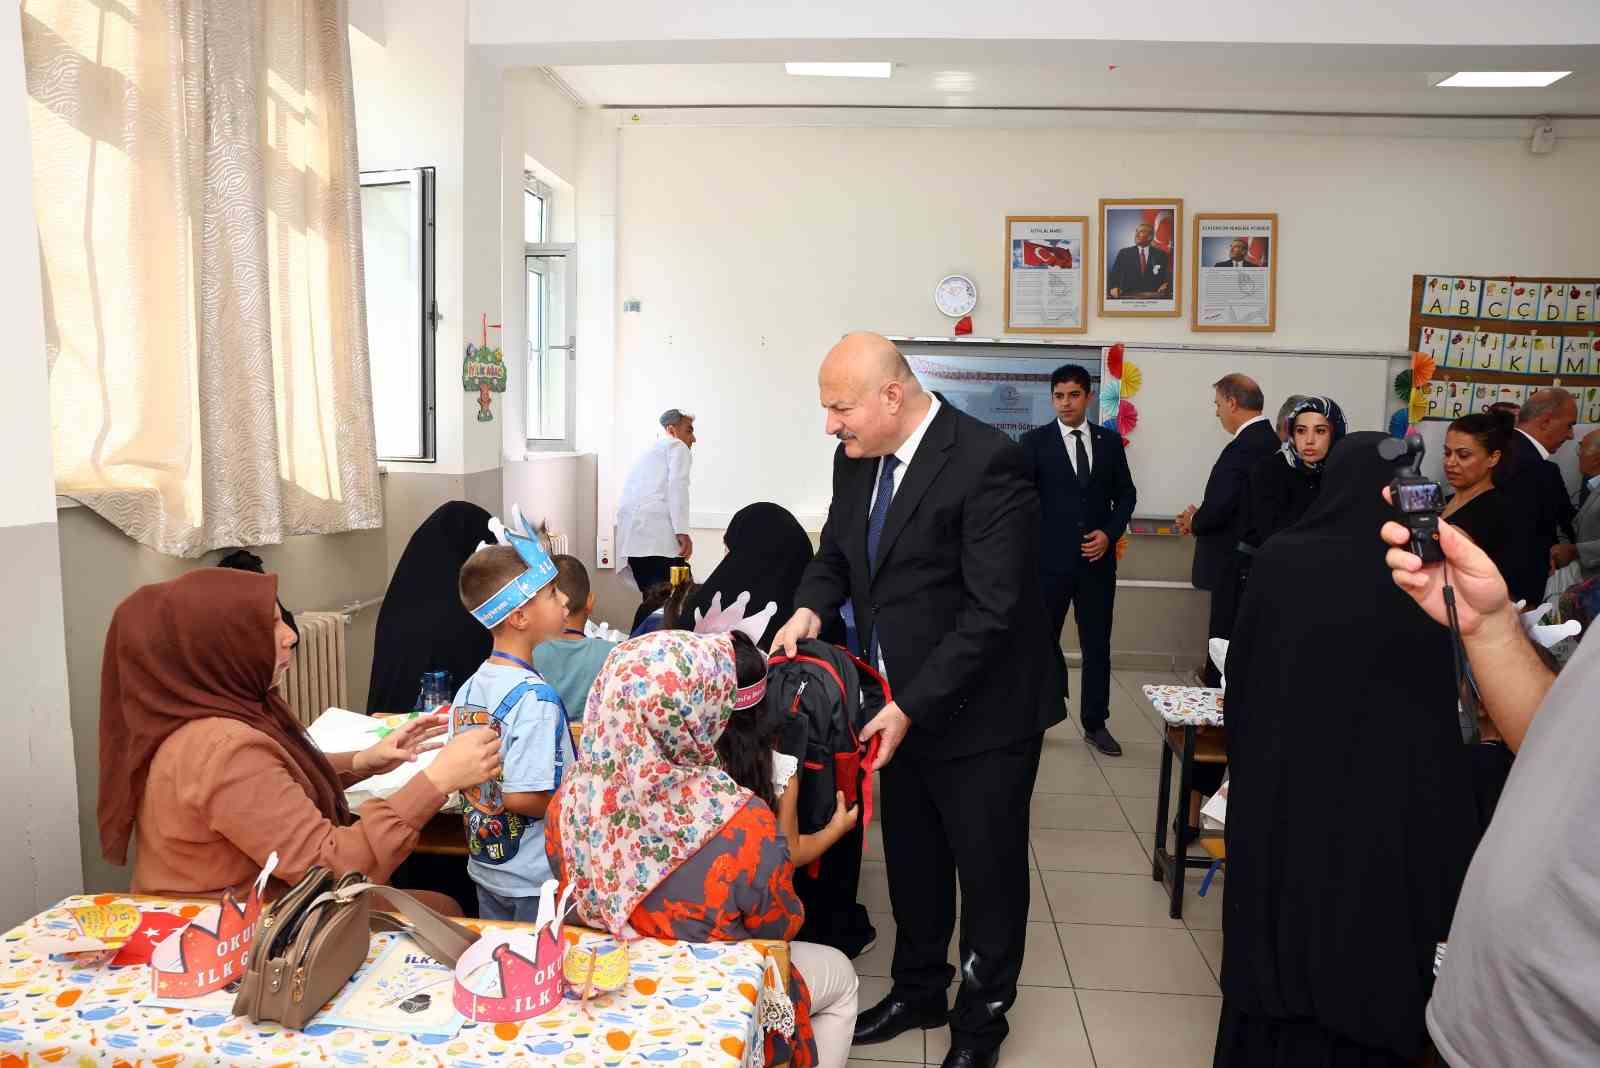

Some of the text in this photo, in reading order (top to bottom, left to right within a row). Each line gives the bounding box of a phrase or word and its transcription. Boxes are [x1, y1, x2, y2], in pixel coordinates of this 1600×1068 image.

[1469, 279, 1476, 292] b
[1429, 298, 1587, 320] A B C Ç D E
[1481, 353, 1492, 368] J
[1509, 355, 1522, 371] K
[1540, 357, 1552, 373] L
[1566, 358, 1585, 372] M
[1437, 386, 1443, 399] p
[1428, 401, 1437, 416] P
[1453, 403, 1462, 418] R
